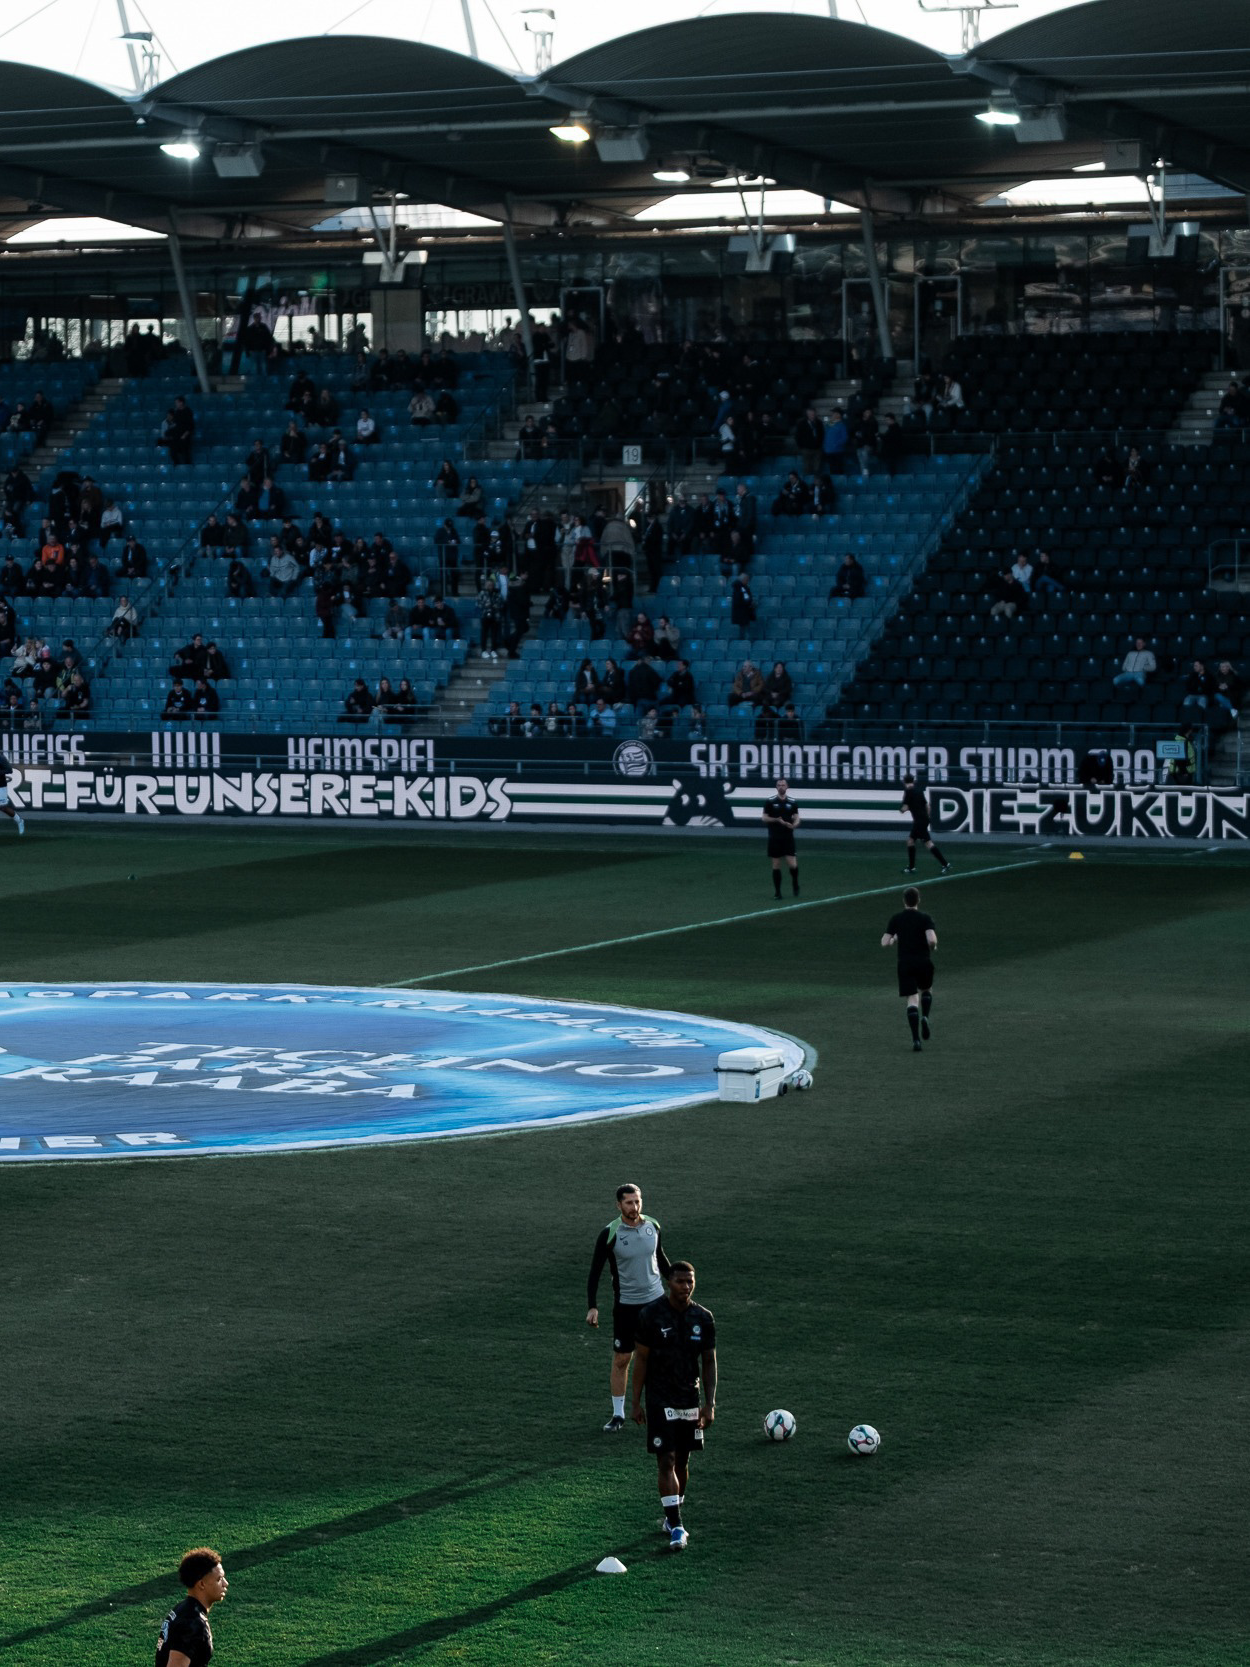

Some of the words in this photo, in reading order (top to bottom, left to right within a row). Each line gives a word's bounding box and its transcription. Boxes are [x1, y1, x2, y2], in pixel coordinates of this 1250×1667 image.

[624, 447, 639, 462] 19
[690, 743, 729, 777] SK
[740, 744, 949, 781] PUNTIGAMER
[960, 747, 1075, 783] STURM
[1088, 748, 1171, 785] RA
[66, 767, 162, 814] FÜR
[174, 772, 381, 816] UNSERE
[393, 775, 514, 821] KIDS
[926, 786, 1020, 834] DIE
